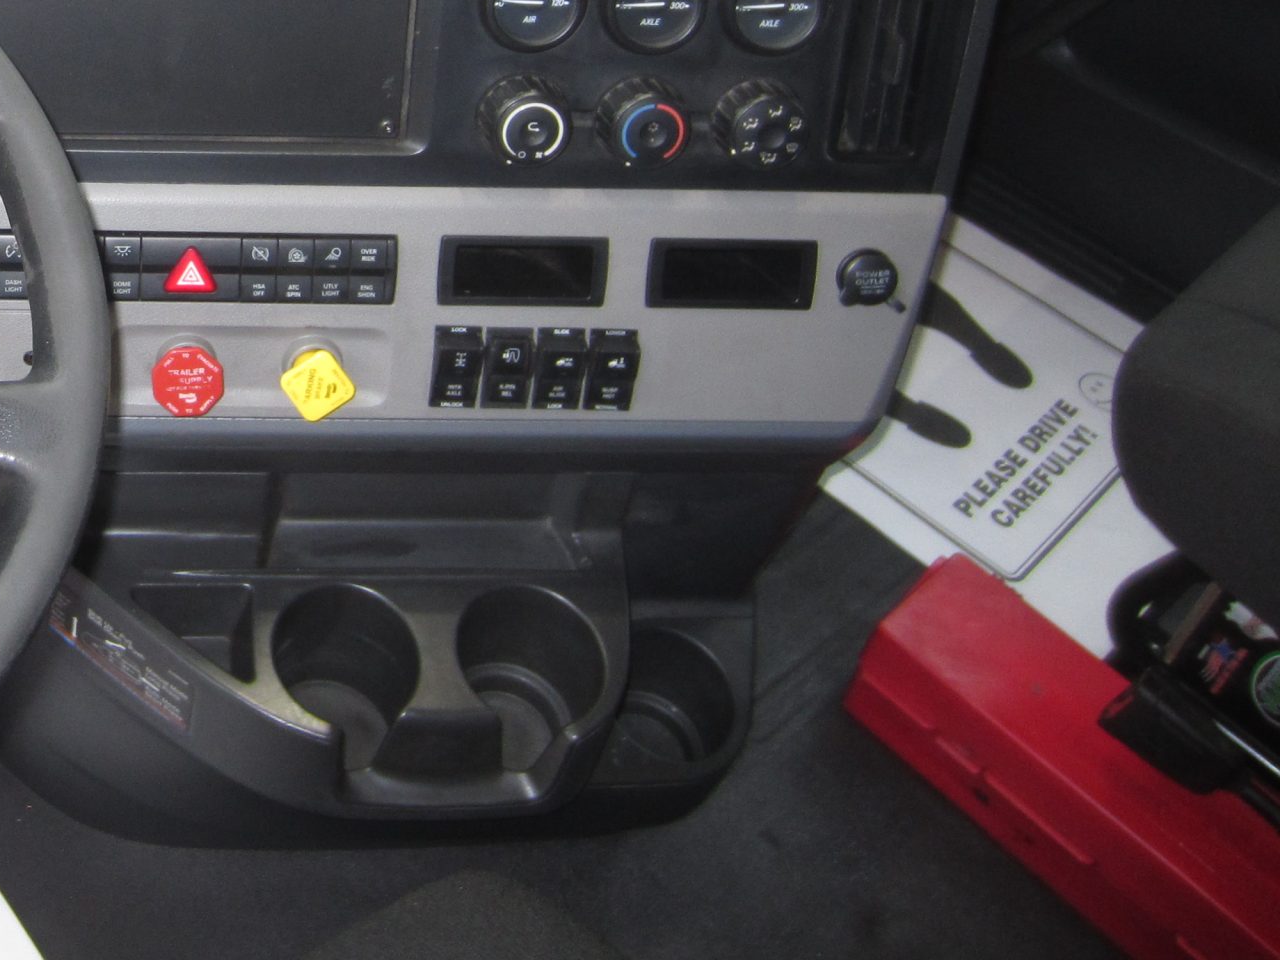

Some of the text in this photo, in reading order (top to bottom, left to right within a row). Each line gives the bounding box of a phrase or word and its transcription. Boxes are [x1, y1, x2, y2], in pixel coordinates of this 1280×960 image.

[669, 1, 686, 10] 300
[788, 3, 804, 12] 300
[522, 15, 537, 24] AIR
[639, 17, 662, 27] AXLE
[759, 19, 781, 28] AXLE
[855, 269, 890, 278] POWER
[855, 278, 889, 286] OUTLET
[167, 367, 205, 376] TRAILER
[952, 398, 1080, 519] PLEASE DRIVE
[990, 425, 1099, 529] CAREFULLY!
